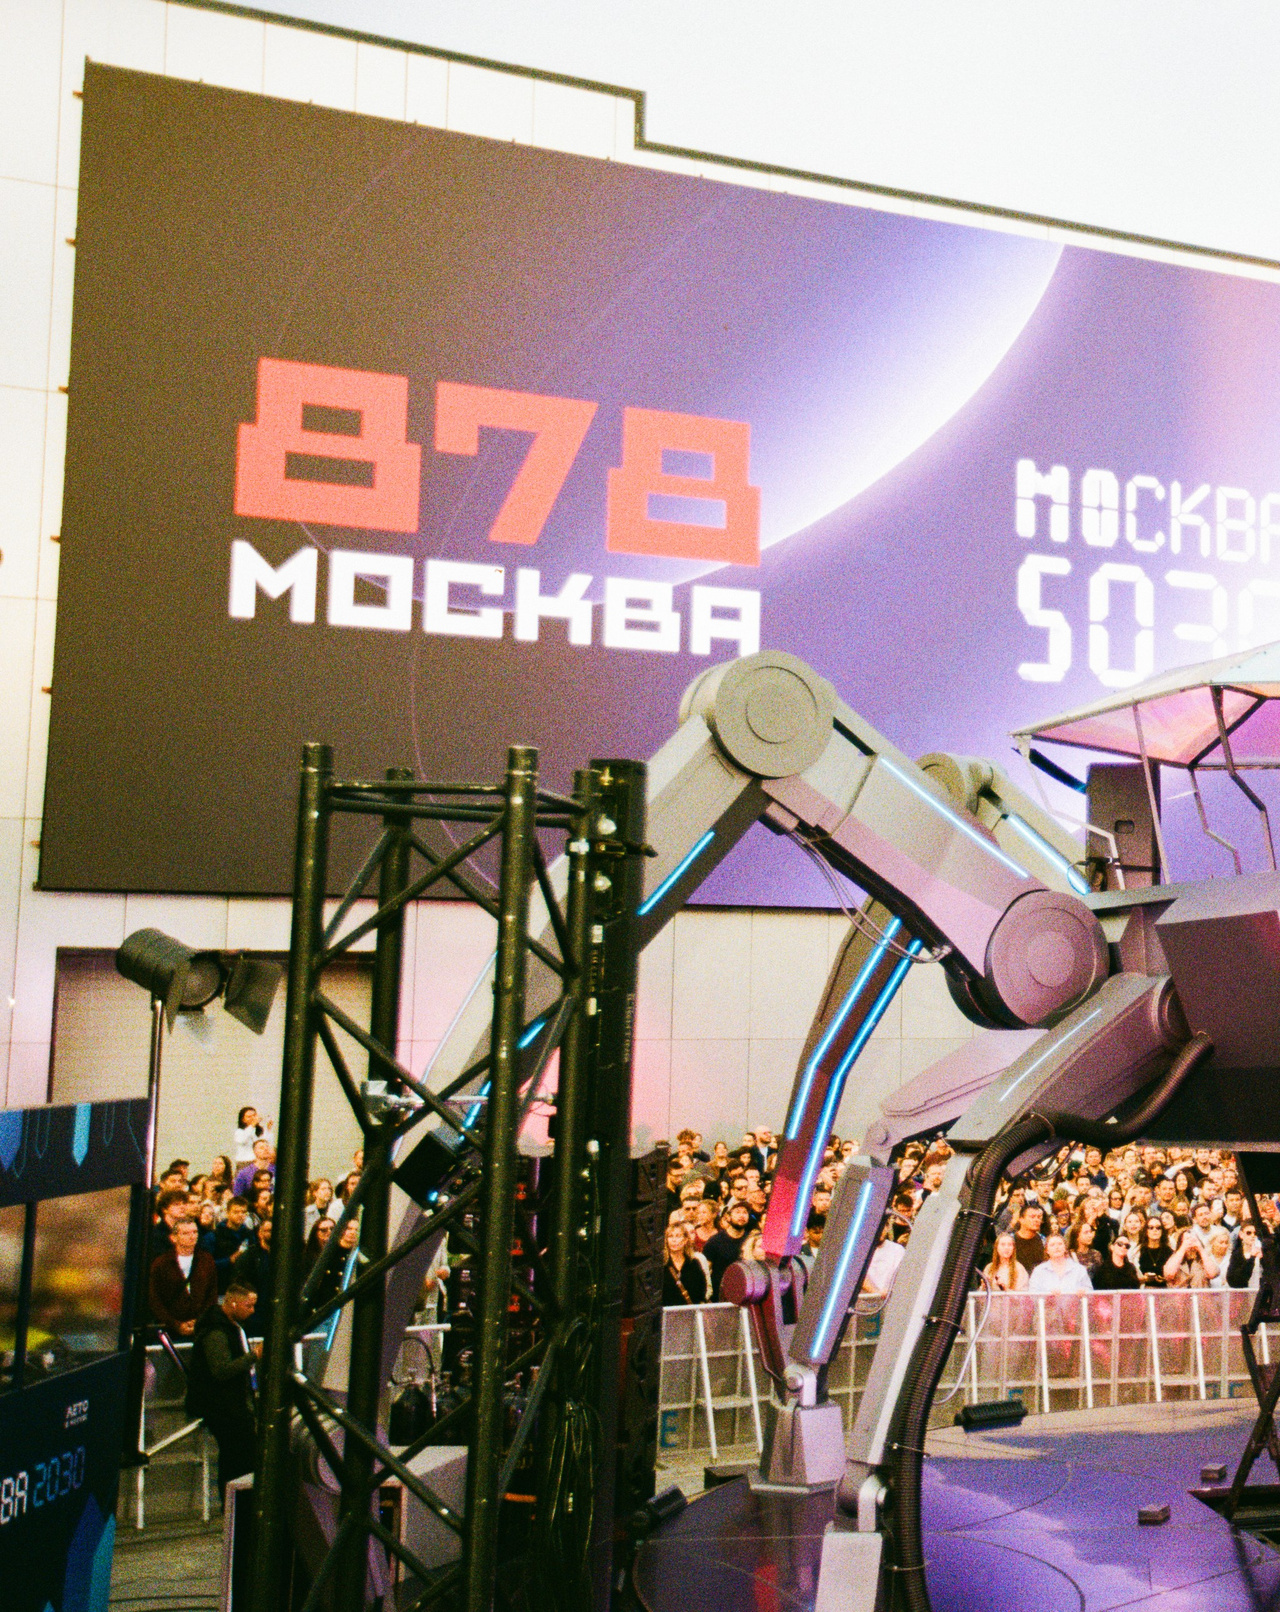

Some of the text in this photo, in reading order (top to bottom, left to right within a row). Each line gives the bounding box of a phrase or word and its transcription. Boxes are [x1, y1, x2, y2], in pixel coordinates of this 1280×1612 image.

[234, 357, 761, 567] 878
[229, 539, 761, 656] МОСКВА
[33, 1446, 86, 1508] 2030
